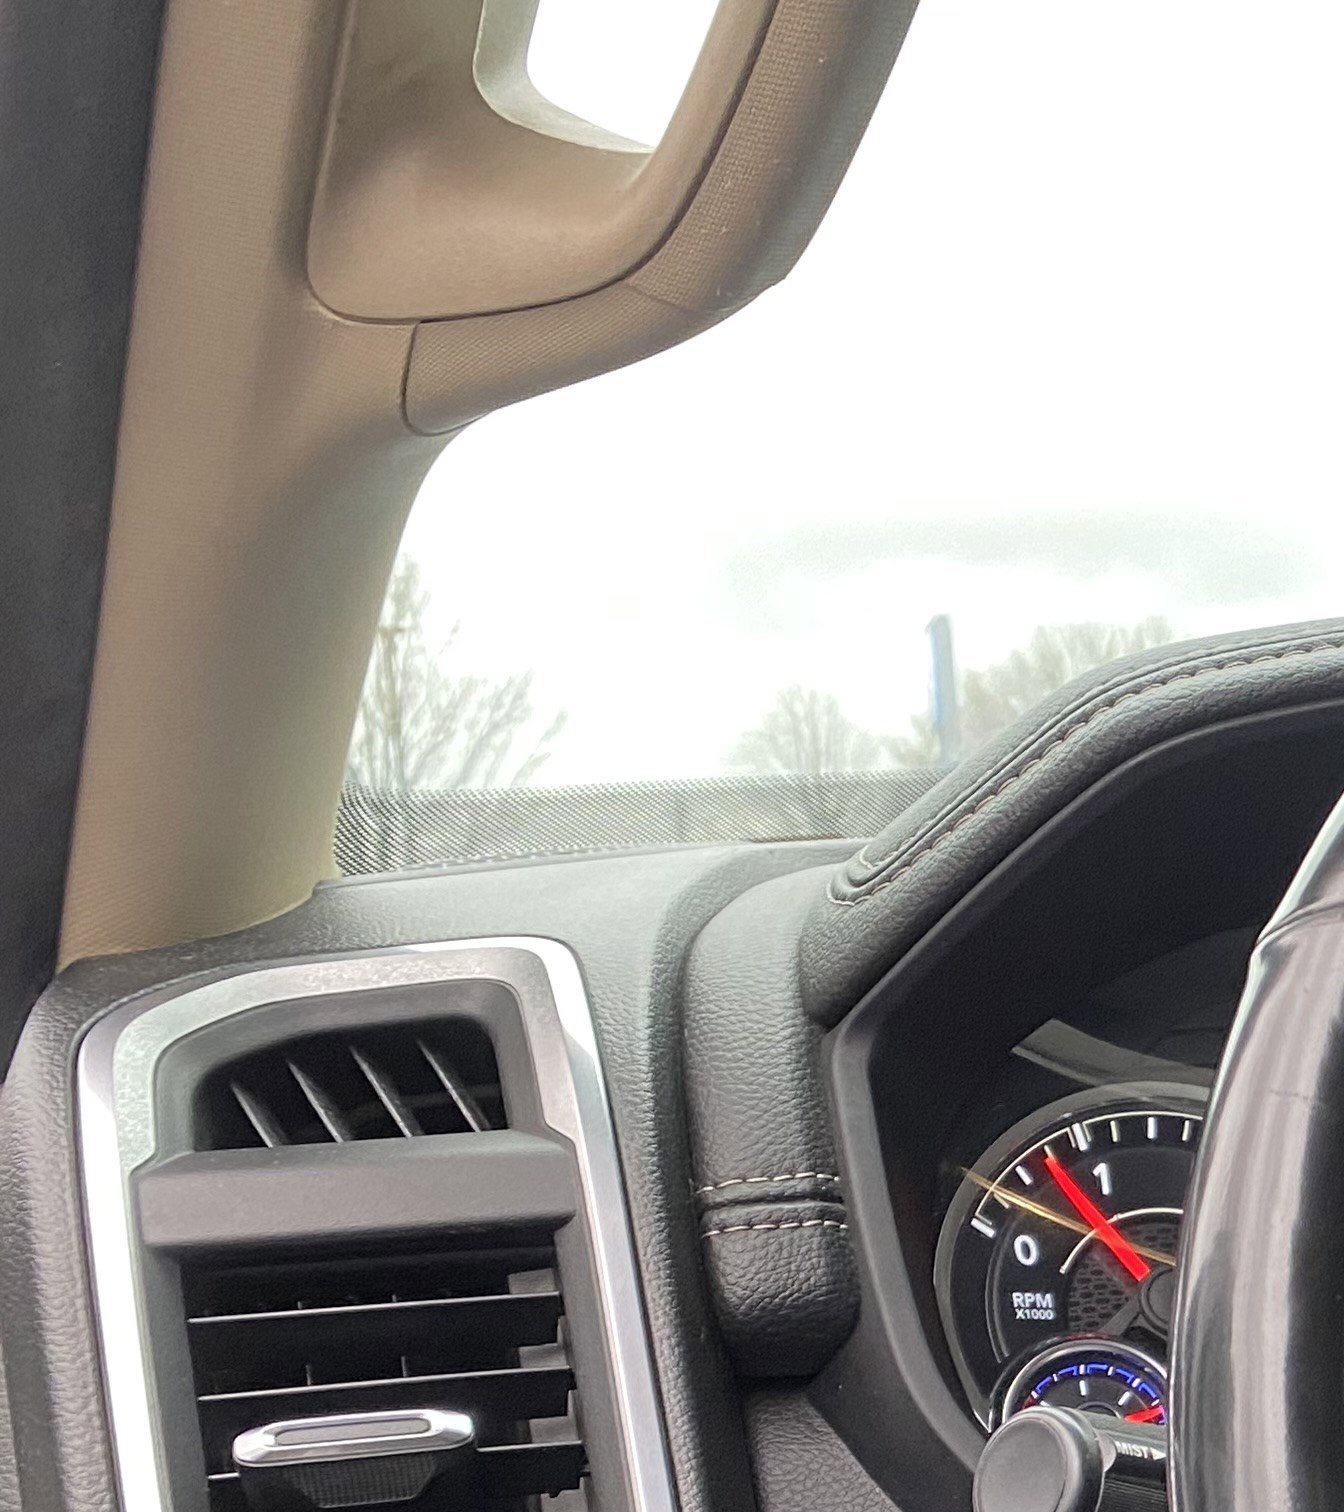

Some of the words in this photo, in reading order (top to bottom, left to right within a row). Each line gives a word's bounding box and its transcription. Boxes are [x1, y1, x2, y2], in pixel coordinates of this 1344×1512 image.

[1092, 1162, 1112, 1196] 1
[1013, 1234, 1039, 1266] 0
[1012, 1292, 1053, 1308] RPM
[1015, 1307, 1054, 1320] X1000
[1113, 1440, 1149, 1460] MIST
